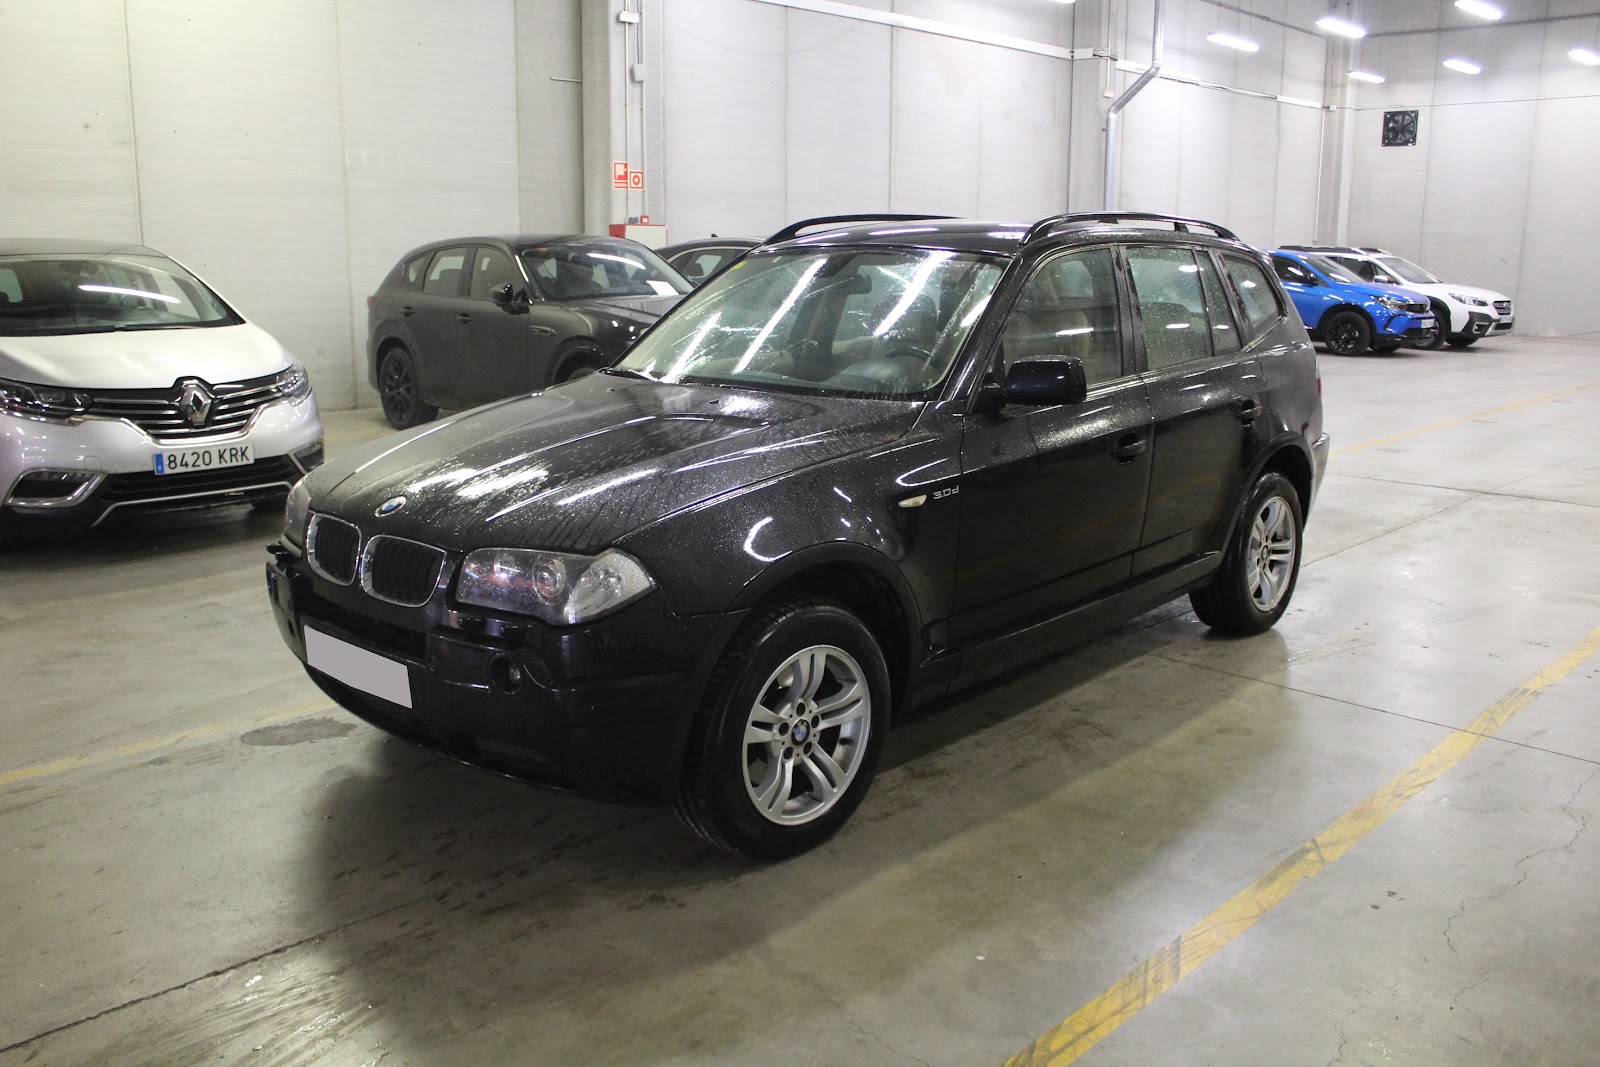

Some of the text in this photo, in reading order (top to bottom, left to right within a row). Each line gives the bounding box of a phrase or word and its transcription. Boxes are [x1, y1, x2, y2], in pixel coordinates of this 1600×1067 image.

[167, 446, 250, 470] 8420 KRK
[933, 485, 960, 500] 3.0d
